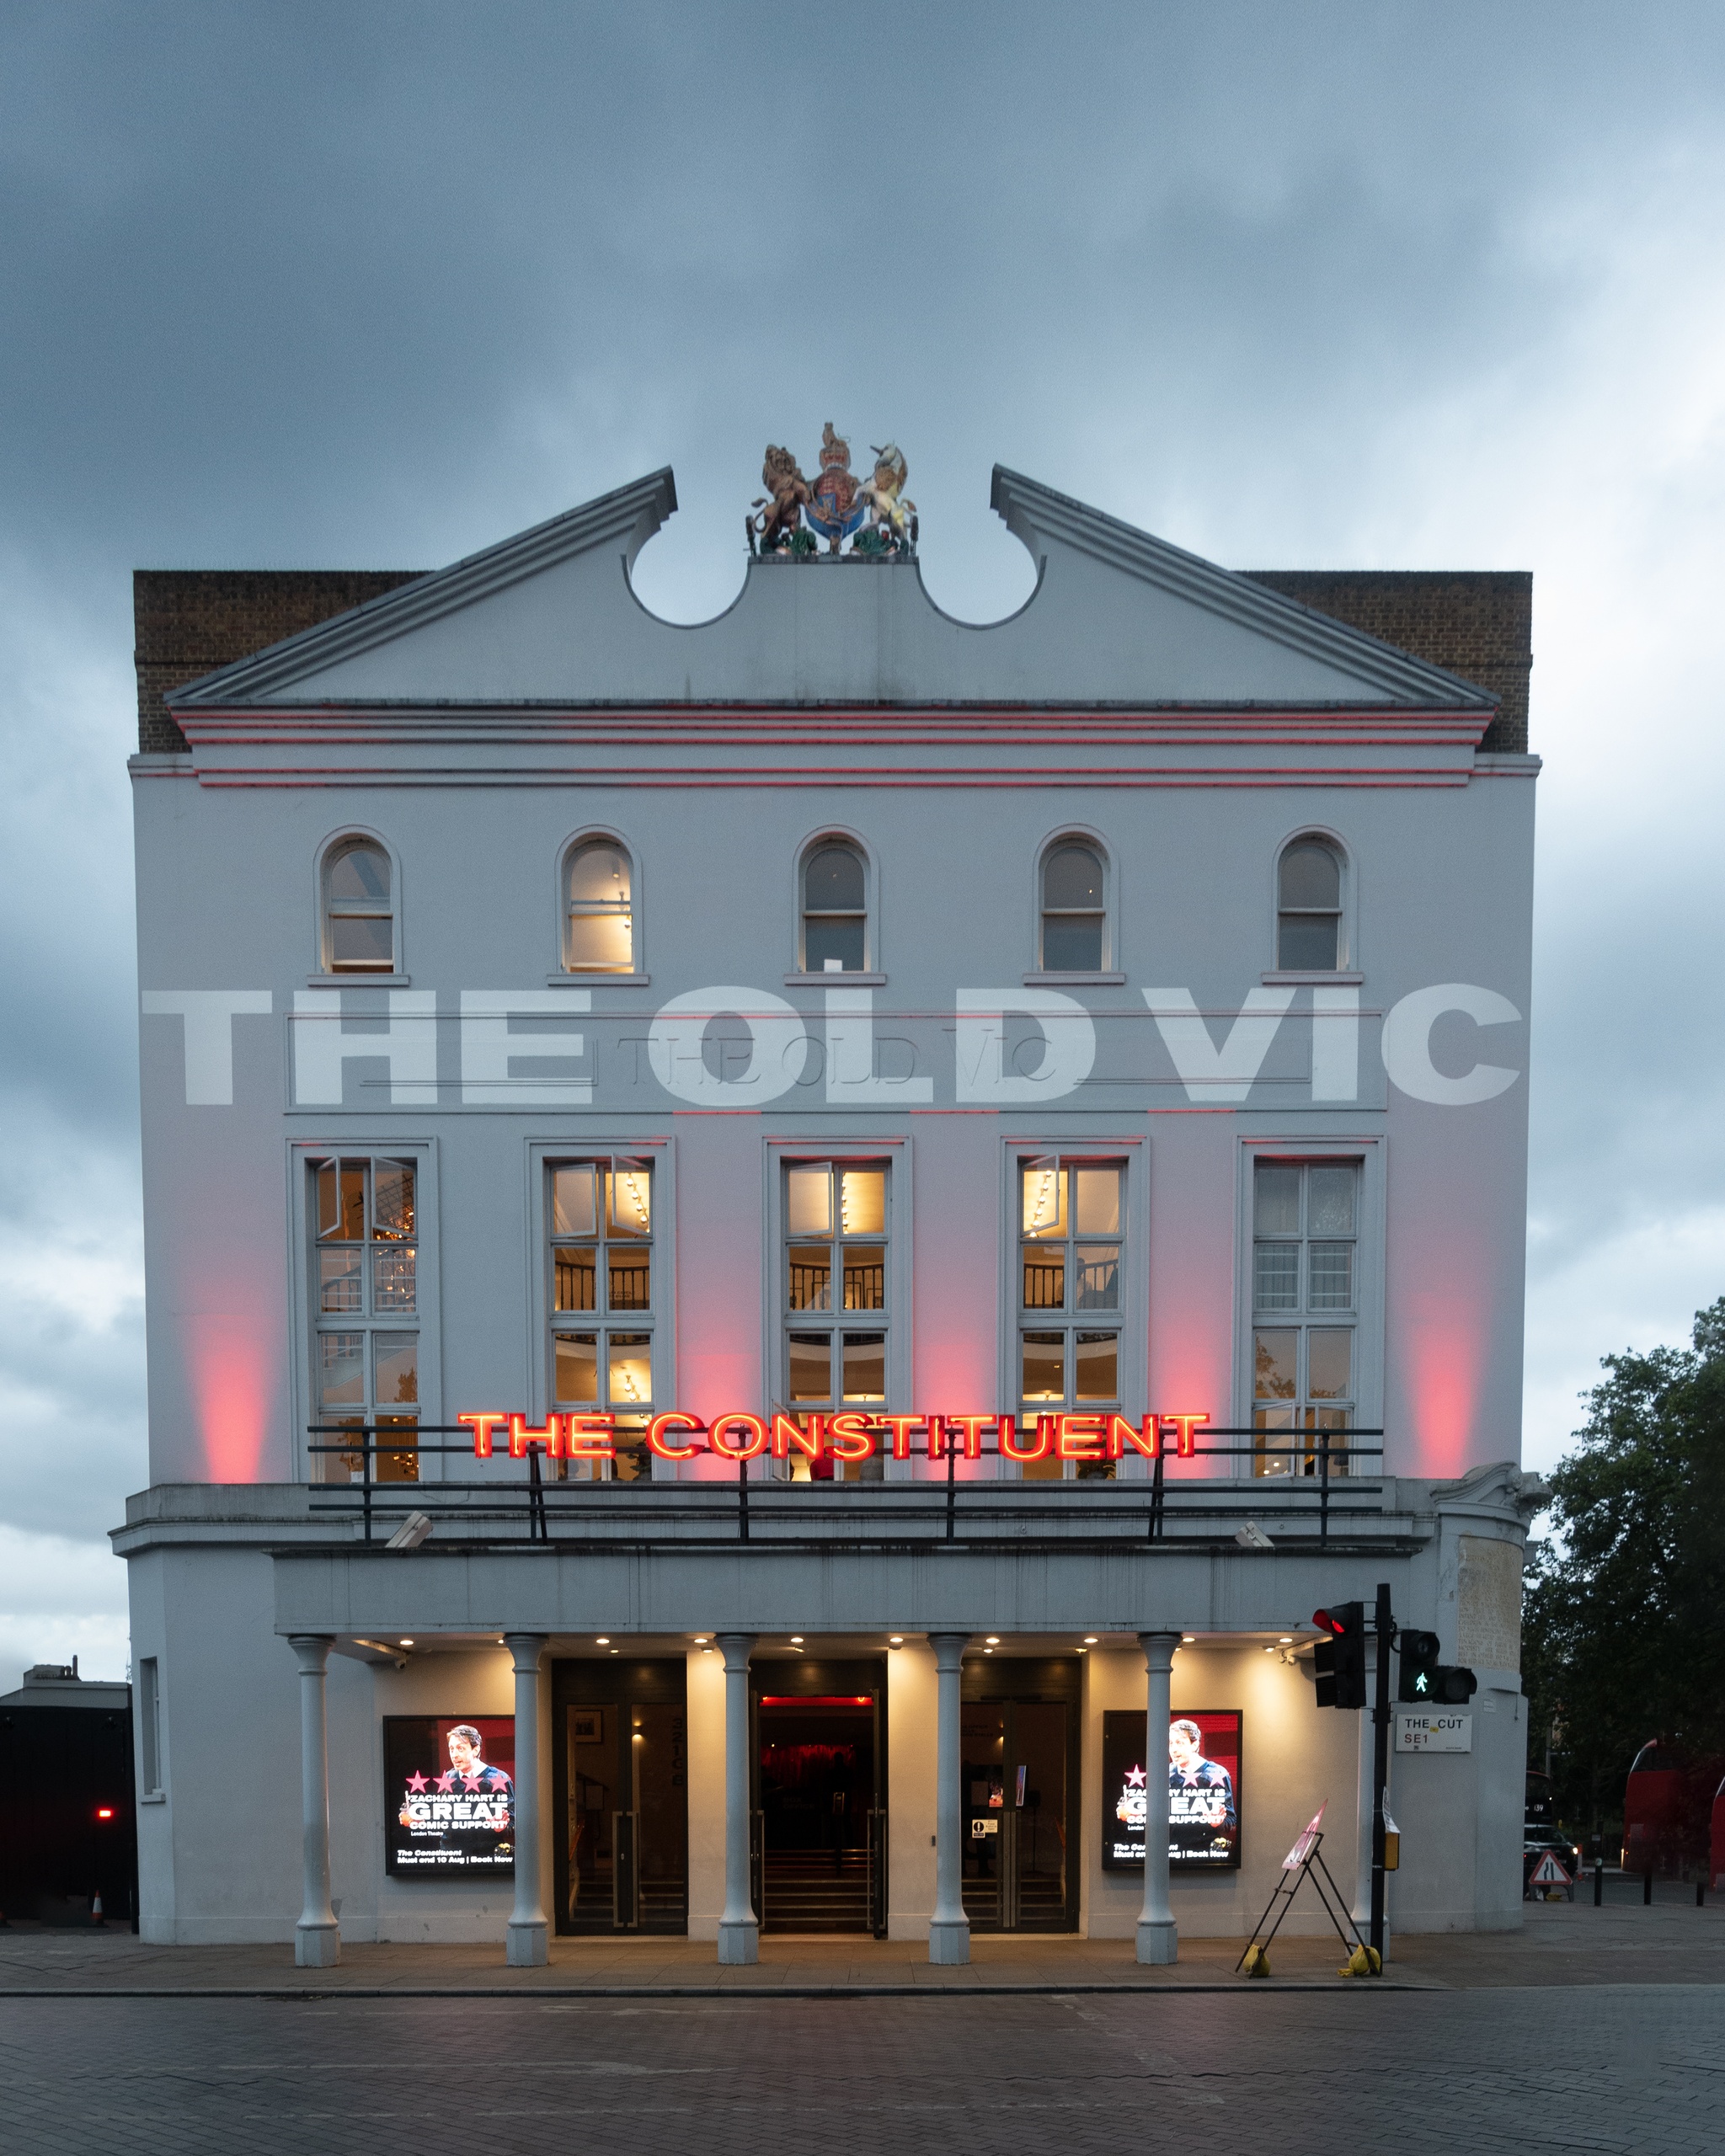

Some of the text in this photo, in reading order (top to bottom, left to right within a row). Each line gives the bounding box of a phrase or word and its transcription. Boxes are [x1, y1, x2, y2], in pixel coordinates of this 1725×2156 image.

[142, 983, 1523, 1107] THE OLD VIC
[617, 1028, 1057, 1087] THE OLD VIC
[457, 1412, 1210, 1462] THE CONSTITUENT
[1405, 1718, 1463, 1729] THE CUT
[1404, 1734, 1428, 1743] SE1
[465, 1794, 494, 1802] HART
[409, 1802, 508, 1820] GREAT
[1126, 1796, 1226, 1815] GEAT
[409, 1821, 449, 1829] COMIC
[448, 1856, 465, 1865] Aug
